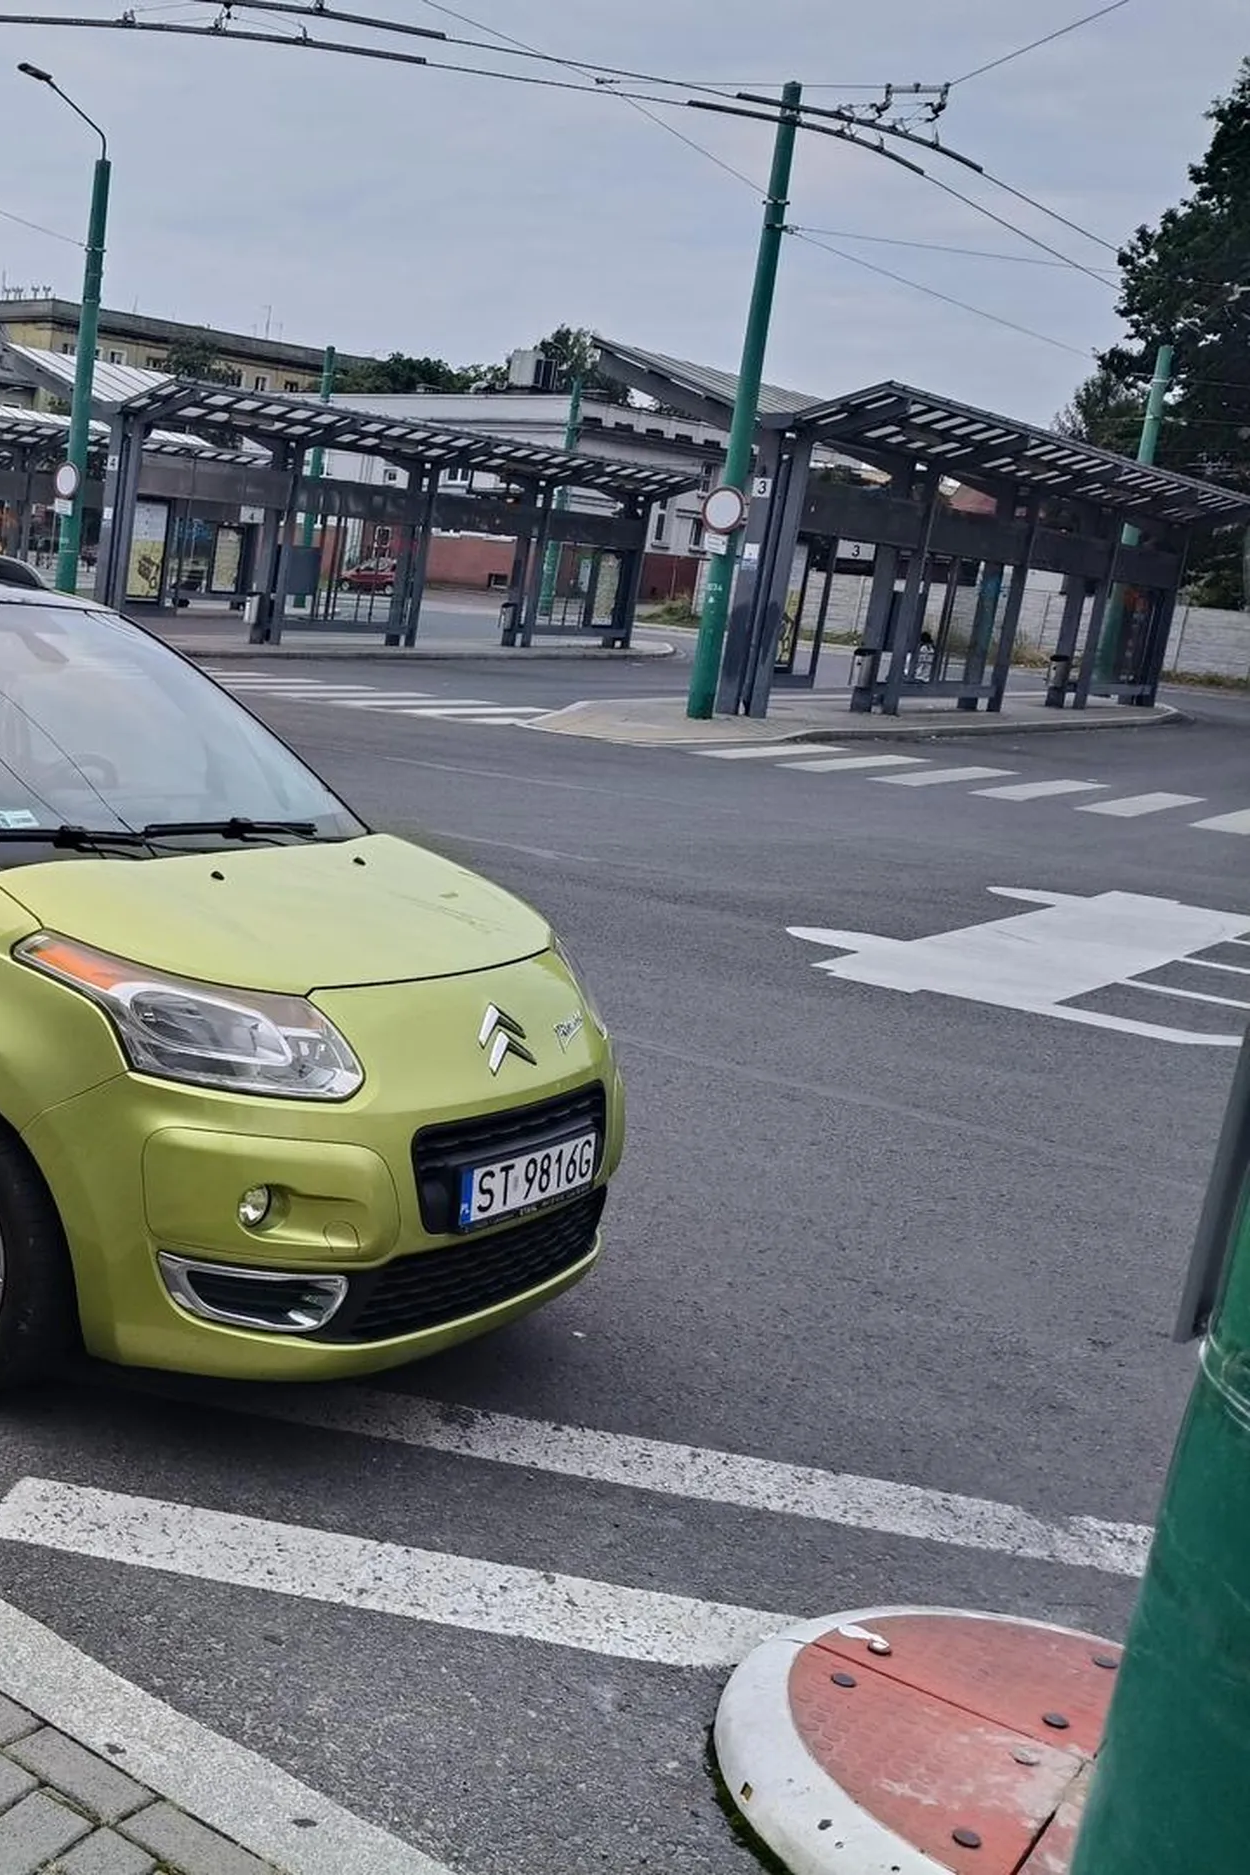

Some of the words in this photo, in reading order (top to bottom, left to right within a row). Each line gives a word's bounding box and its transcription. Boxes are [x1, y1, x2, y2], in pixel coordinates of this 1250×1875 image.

[757, 480, 767, 495] 3
[851, 544, 860, 557] 3
[477, 1164, 515, 1213] ST
[524, 1139, 592, 1200] 9816G
